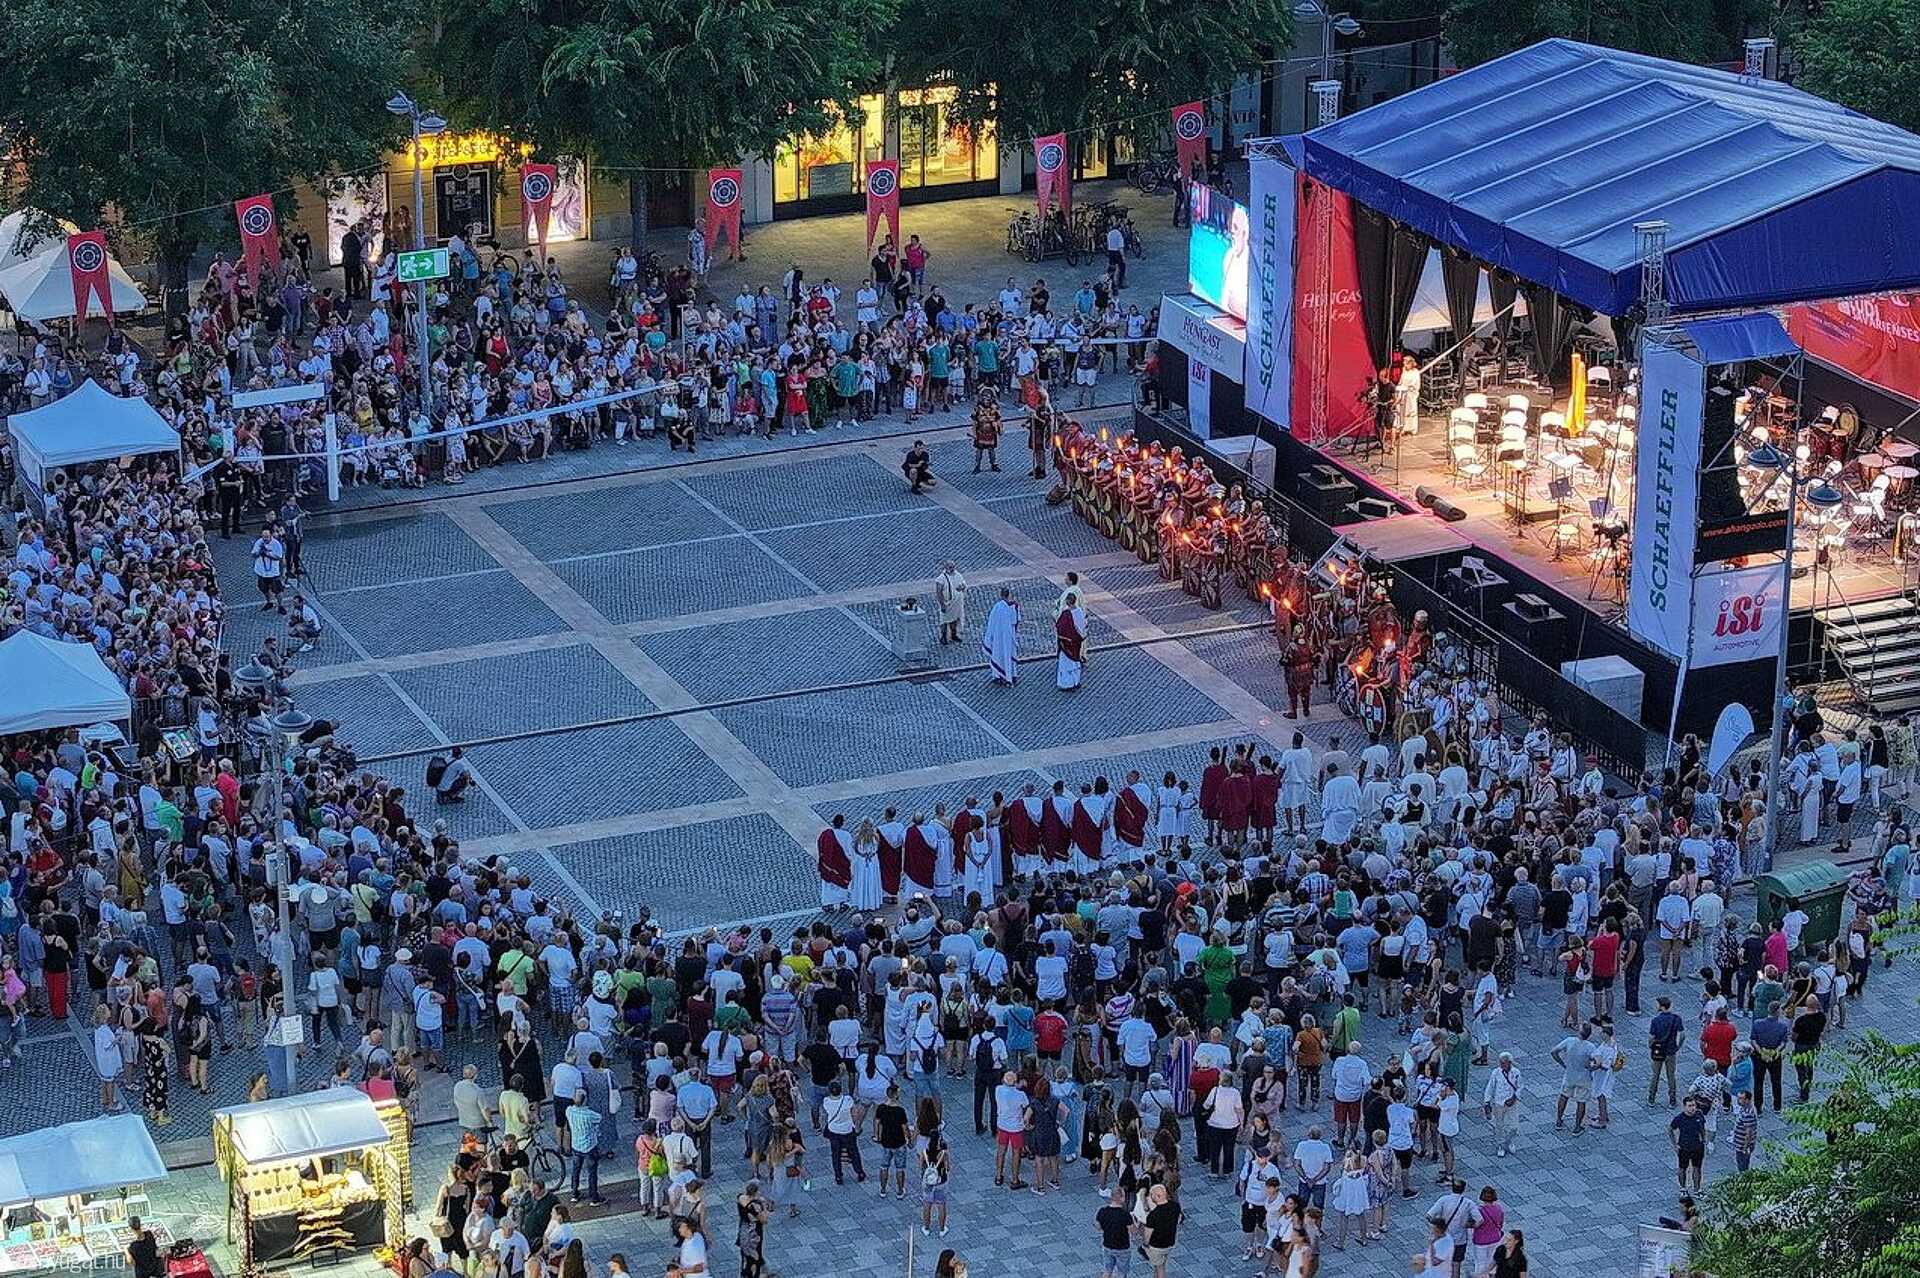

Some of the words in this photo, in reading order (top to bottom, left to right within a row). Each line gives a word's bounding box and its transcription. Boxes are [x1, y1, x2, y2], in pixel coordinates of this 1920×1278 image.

[1259, 194, 1277, 387] SCHAEFFLER
[1650, 388, 1678, 612] SCHAEFFLER
[1711, 595, 1765, 637] iSi
[1713, 639, 1760, 651] AUTOMOTIVE
